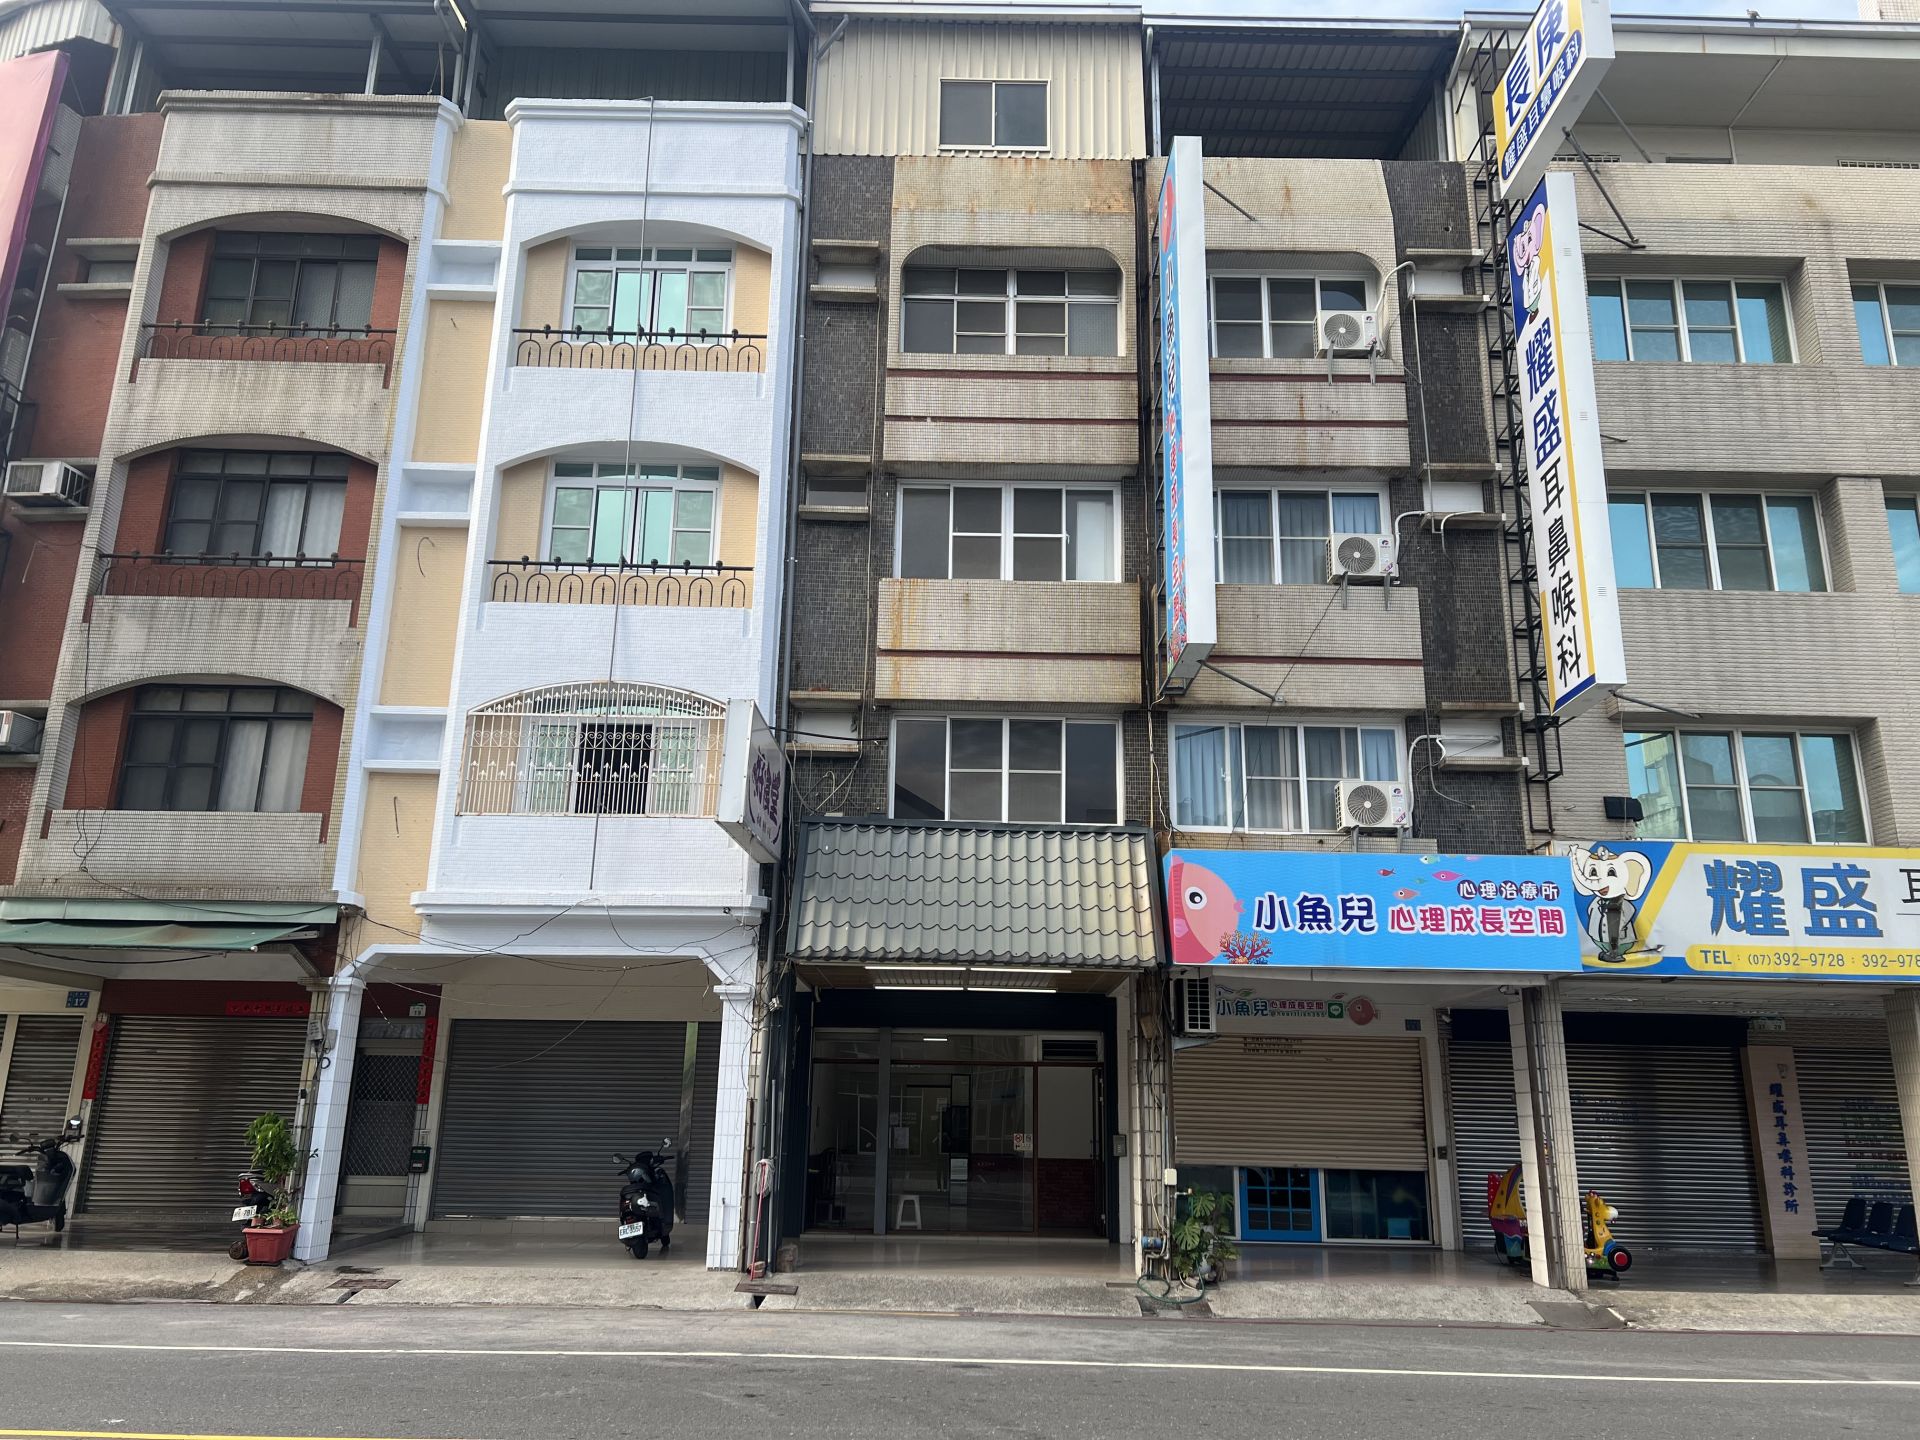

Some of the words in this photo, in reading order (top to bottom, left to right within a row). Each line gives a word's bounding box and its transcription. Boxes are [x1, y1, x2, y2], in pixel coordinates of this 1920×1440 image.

[1525, 316, 1582, 688] 耀盛耳鼻喉科
[1458, 881, 1560, 900] 心理治療所
[1703, 859, 1884, 938] 耀盛
[1254, 893, 1376, 933] 小魚兒
[1390, 906, 1566, 935] 心理成長空間
[73, 998, 86, 1006] 17
[1216, 1000, 1269, 1017] 小魚兒
